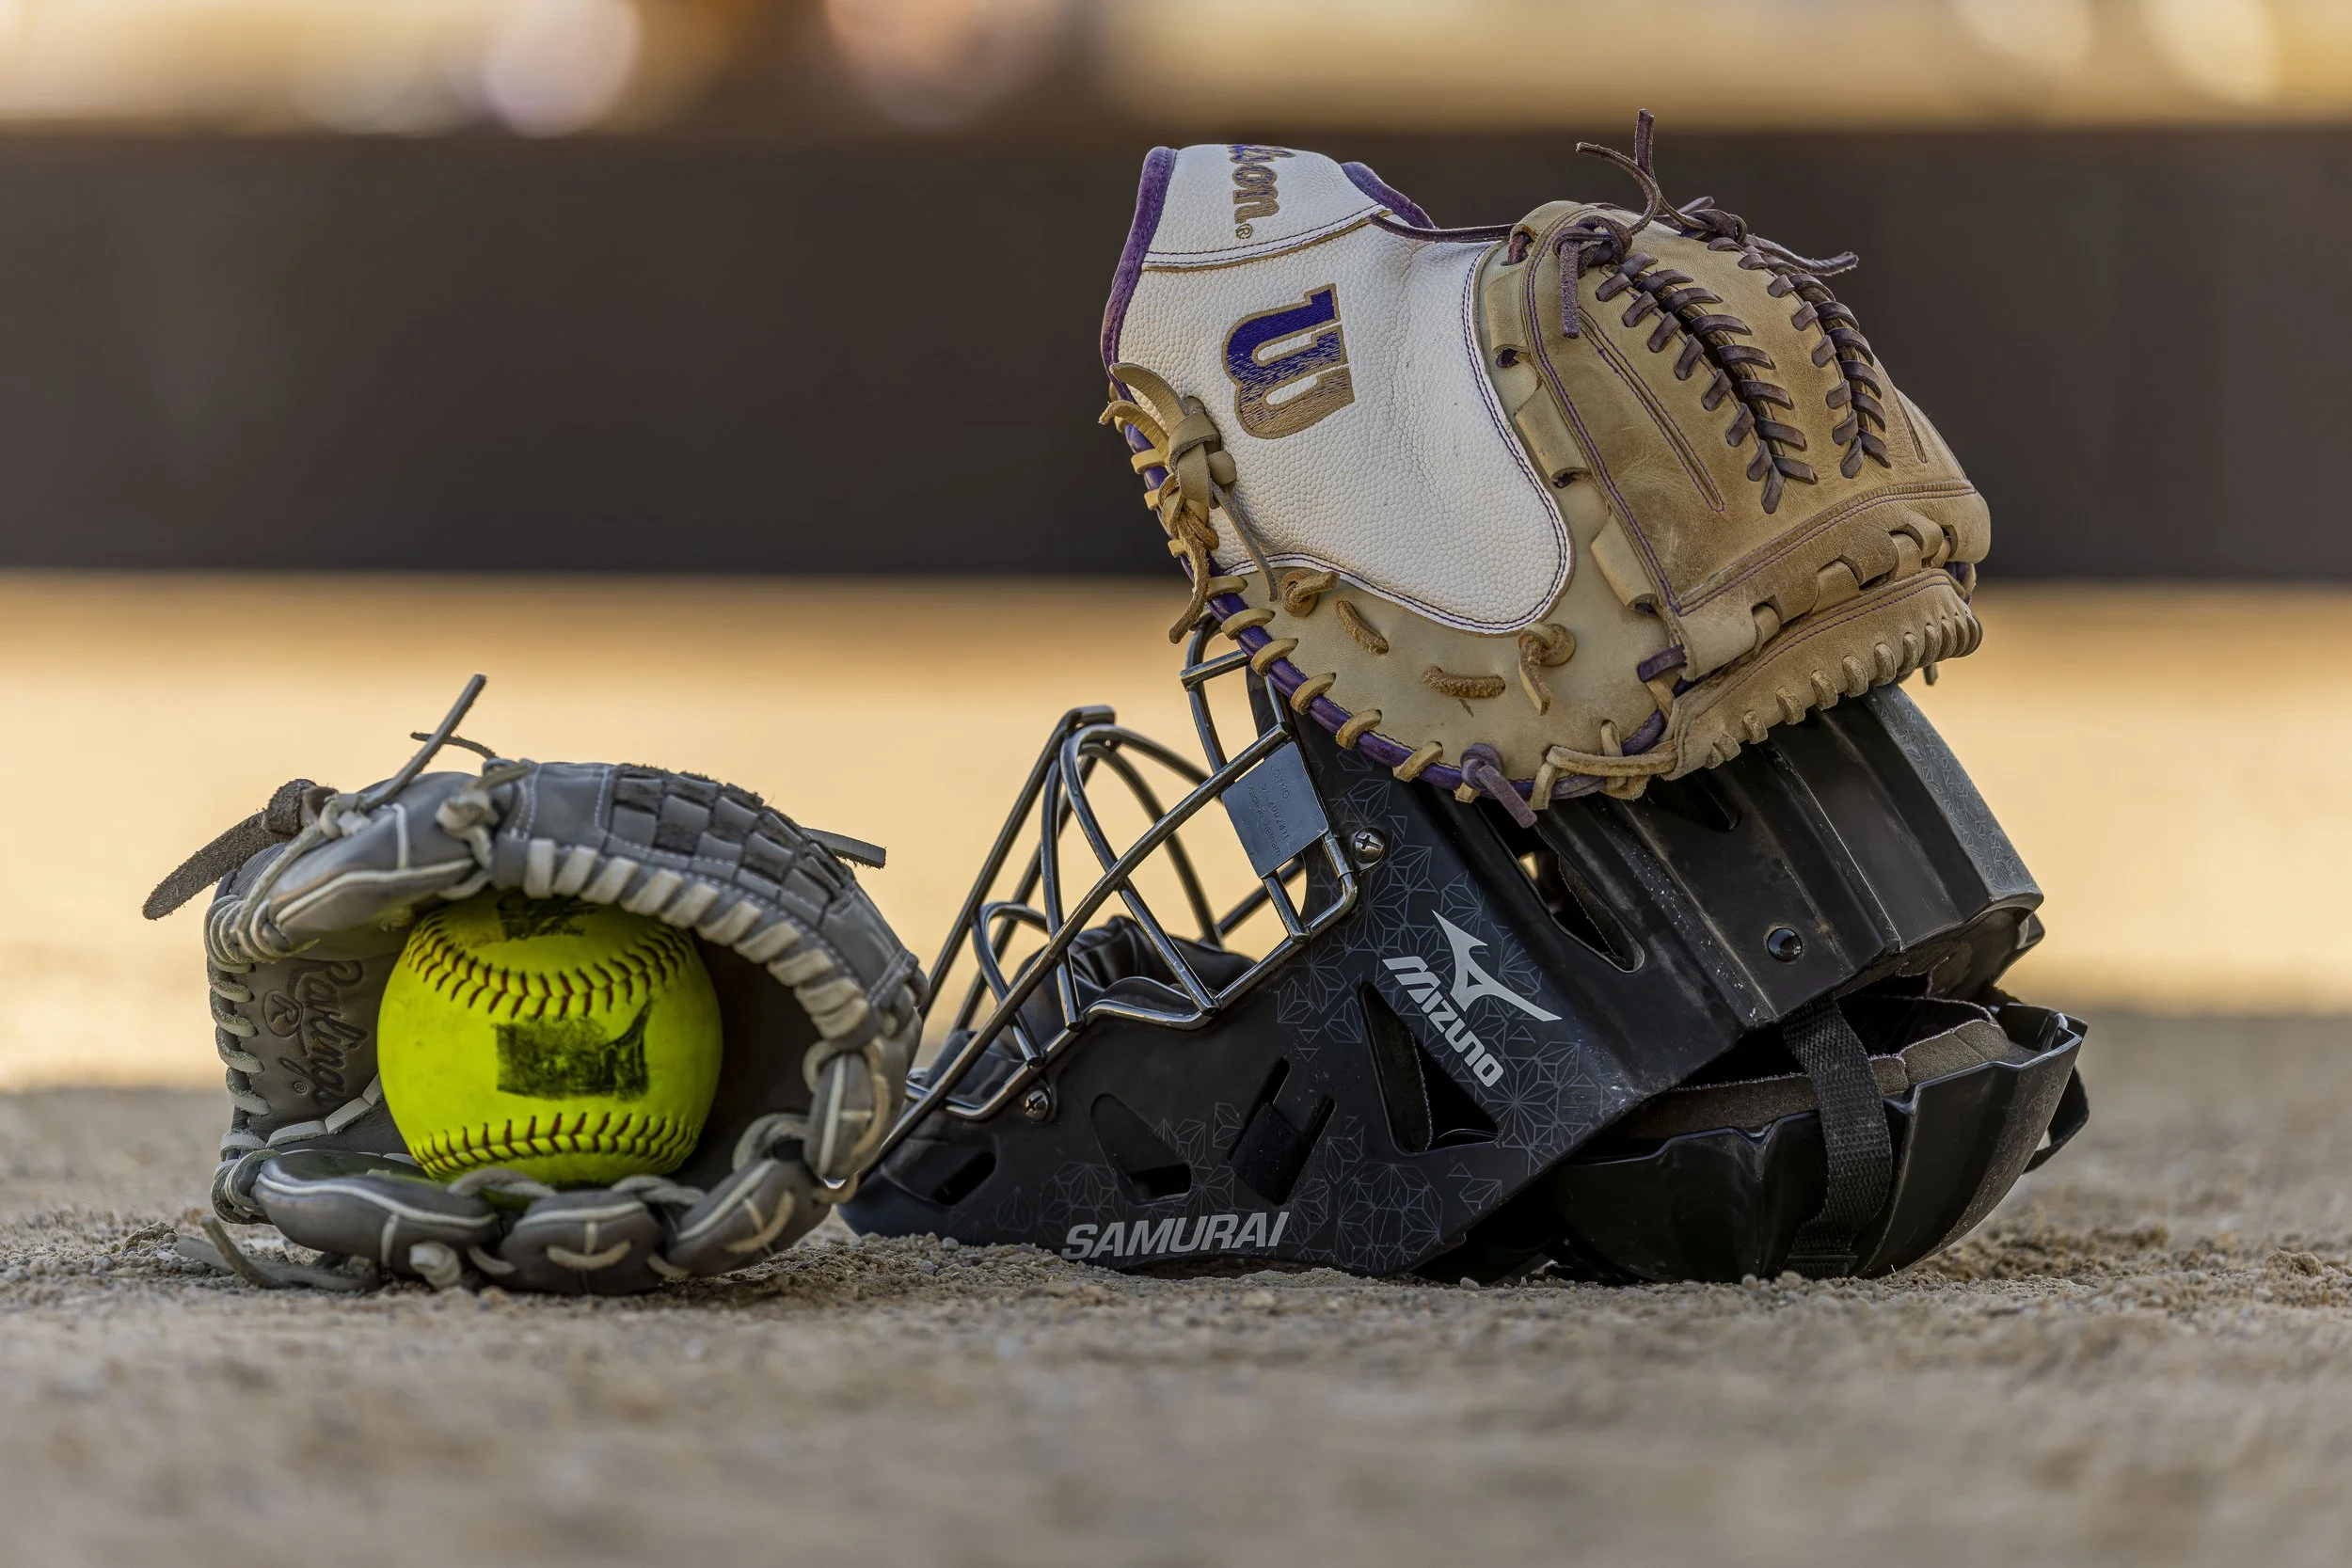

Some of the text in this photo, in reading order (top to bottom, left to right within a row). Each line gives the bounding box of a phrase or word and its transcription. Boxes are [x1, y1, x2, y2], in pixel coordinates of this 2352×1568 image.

[1246, 783, 1262, 808] Made
[1263, 819, 1282, 857] Vietnam
[1060, 1212, 1290, 1260] SAMURAI
